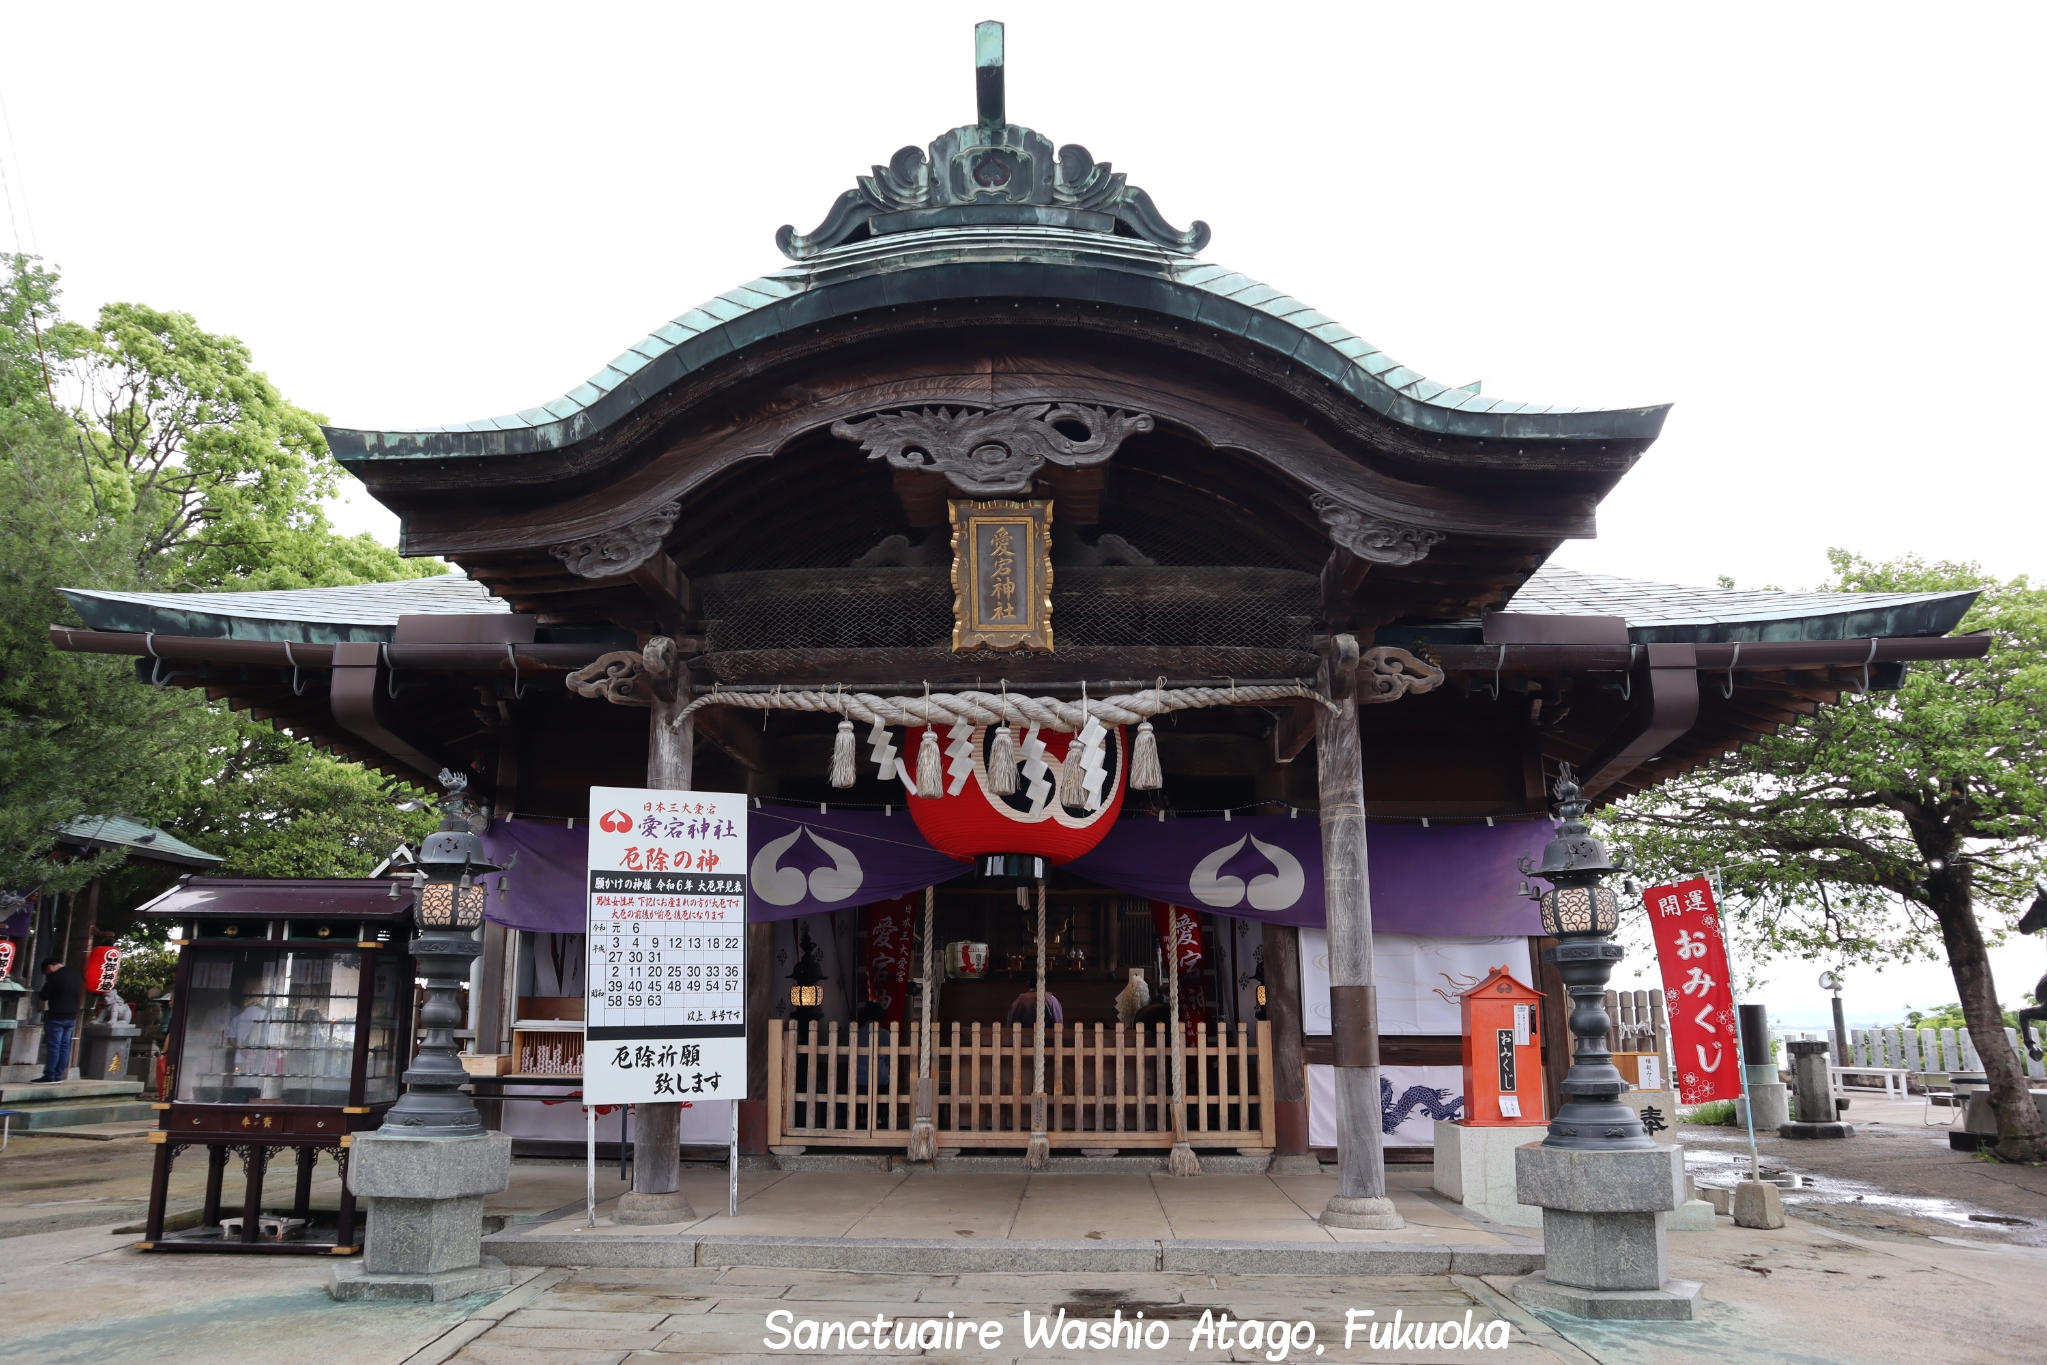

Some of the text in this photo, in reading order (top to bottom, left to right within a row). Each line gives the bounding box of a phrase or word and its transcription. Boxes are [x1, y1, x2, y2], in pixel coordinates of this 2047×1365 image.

[990, 526, 1017, 622] 愛宕神社
[643, 802, 716, 815] 日本三大愛宕
[638, 815, 737, 840] 愛宕神社
[619, 846, 719, 872] 厄除の神
[594, 877, 742, 893] 願かけの神様 令和6年 大厄早見表
[596, 896, 634, 906] 男性女性共
[1658, 889, 1709, 918] 開運
[593, 923, 639, 933] 令和 元 6
[592, 945, 605, 953] 平成
[613, 937, 738, 948] 3 4 9 12 13 18 22
[896, 905, 912, 983] 日本三大愛宕
[609, 952, 660, 962] 27 30 31
[612, 966, 738, 977] 2 11 20 25 30 33 36
[591, 989, 604, 997] 昭和
[609, 981, 738, 992] 39 40 45 48 49 54 57
[608, 995, 661, 1006] 58 59 63
[1674, 929, 1723, 1073] おみくじ
[687, 1010, 740, 1022] 以上、年号です
[108, 1052, 122, 1075] 奉
[612, 1044, 700, 1069] 厄除祈願
[1501, 1032, 1513, 1089] おみくじ
[654, 1072, 722, 1095] 致します
[1640, 1105, 1668, 1136] 奉
